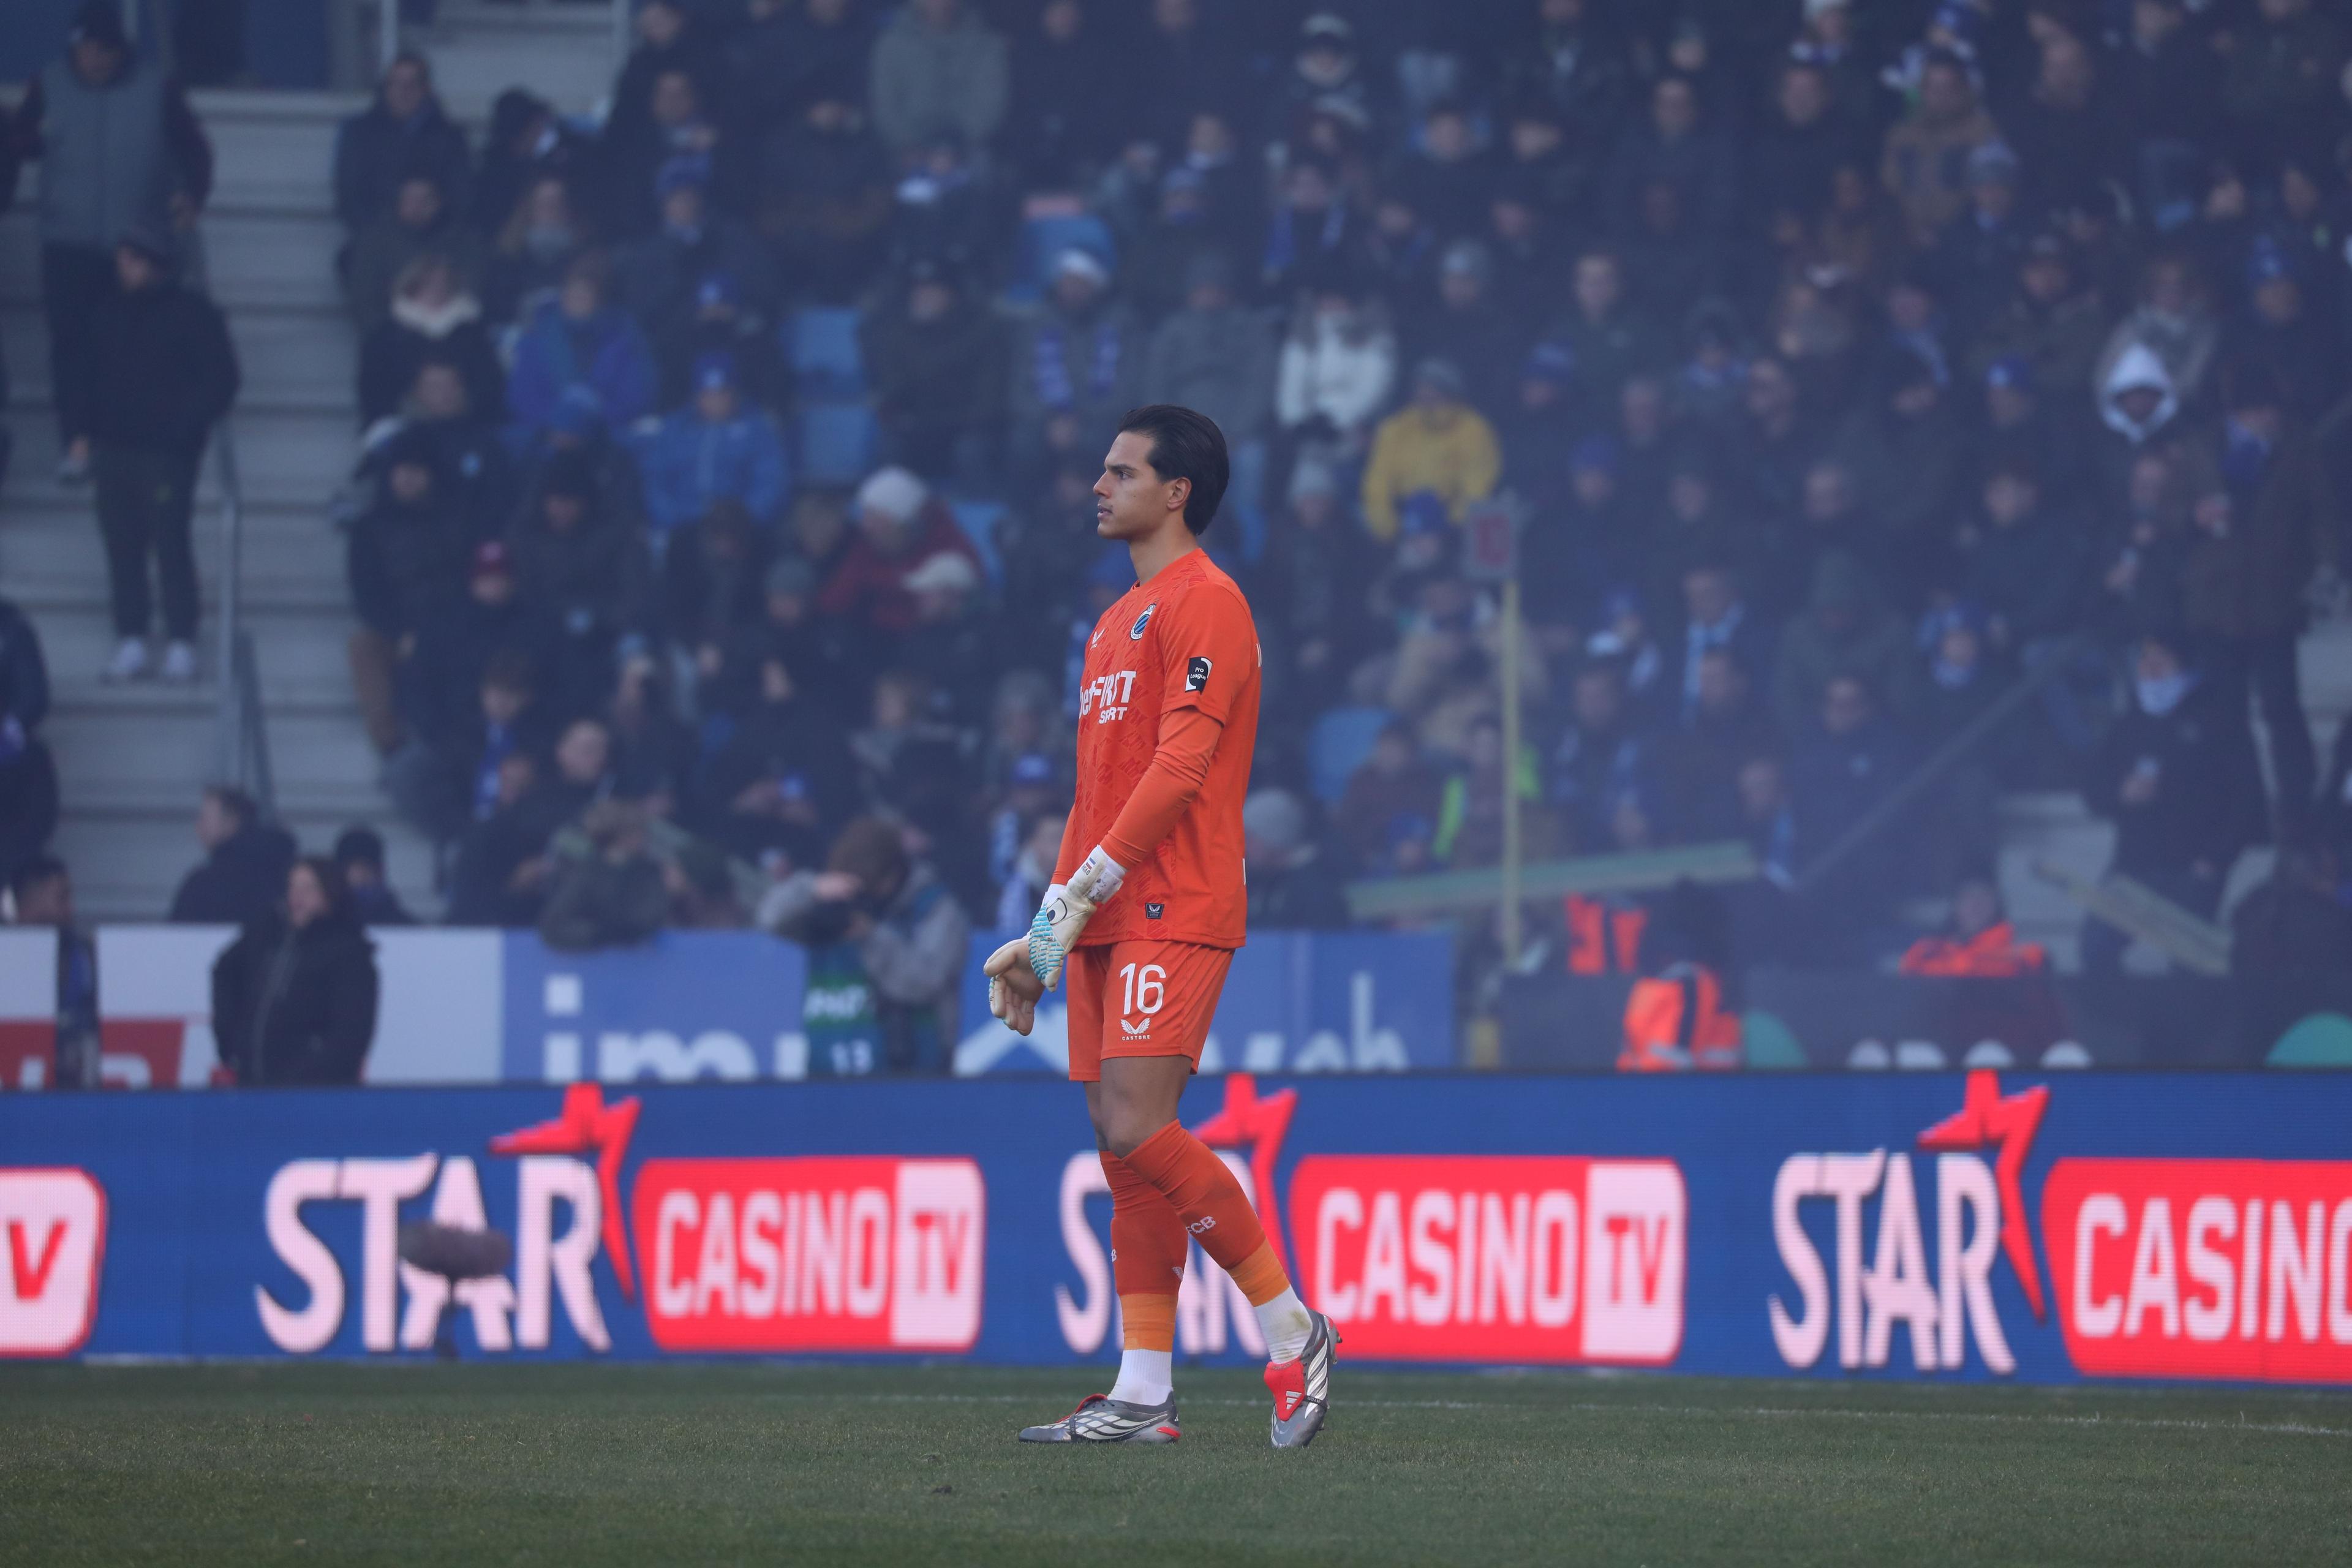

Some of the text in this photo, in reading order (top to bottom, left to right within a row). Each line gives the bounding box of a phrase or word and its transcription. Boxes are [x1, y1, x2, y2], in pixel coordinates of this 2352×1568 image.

[1120, 963, 1166, 1015] 16
[256, 1153, 968, 1352] STAR CASINO TV
[1316, 1187, 1580, 1328] CASINO
[1605, 1212, 1667, 1306] TV
[1769, 1148, 2016, 1376] STAR
